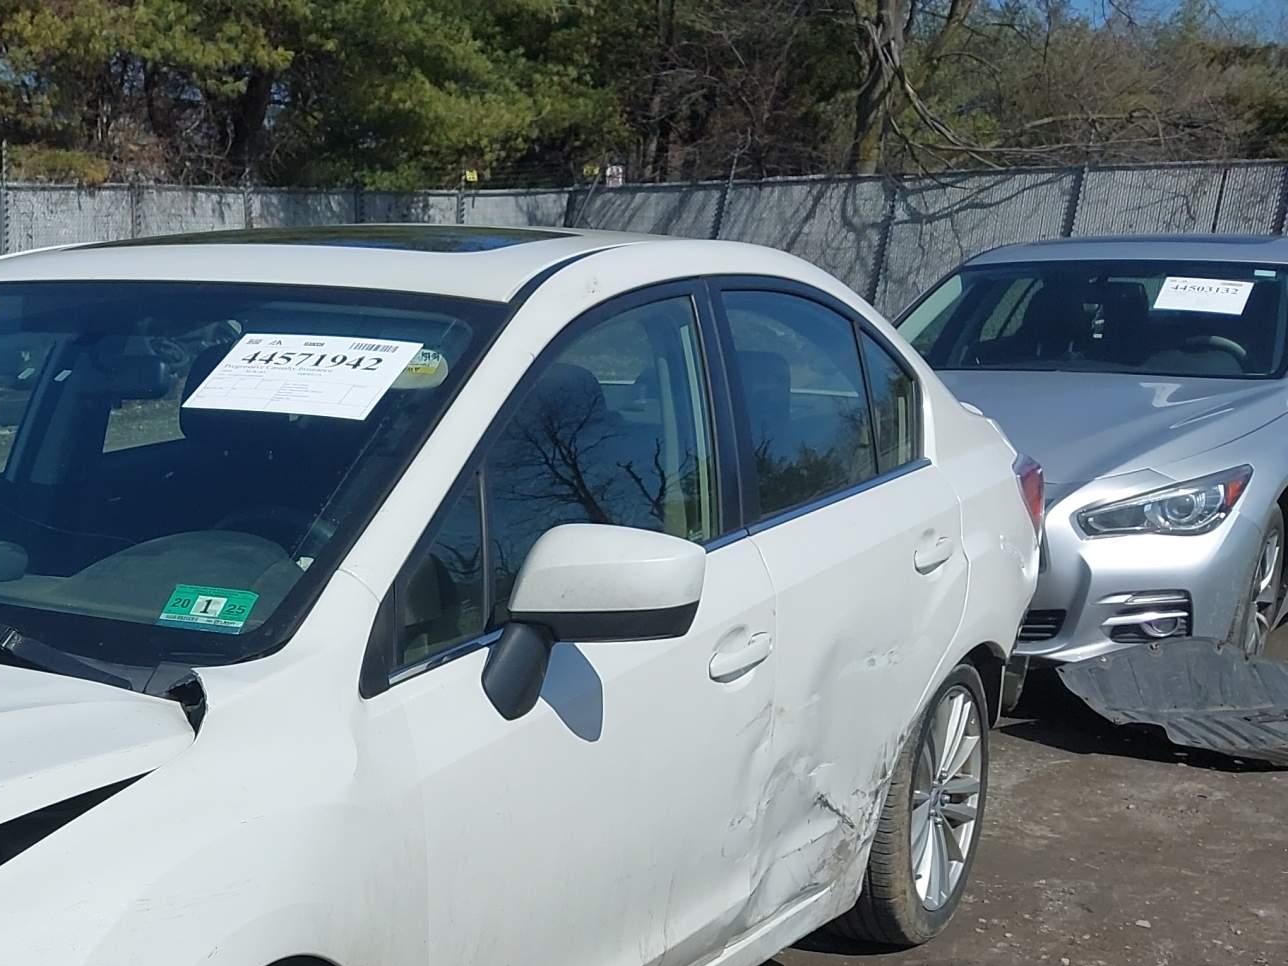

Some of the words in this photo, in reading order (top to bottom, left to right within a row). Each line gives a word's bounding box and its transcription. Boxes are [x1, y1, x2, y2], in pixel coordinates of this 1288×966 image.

[241, 350, 384, 372] 44571942
[171, 597, 191, 609] 20
[199, 599, 213, 614] 1
[225, 604, 247, 615] 25
